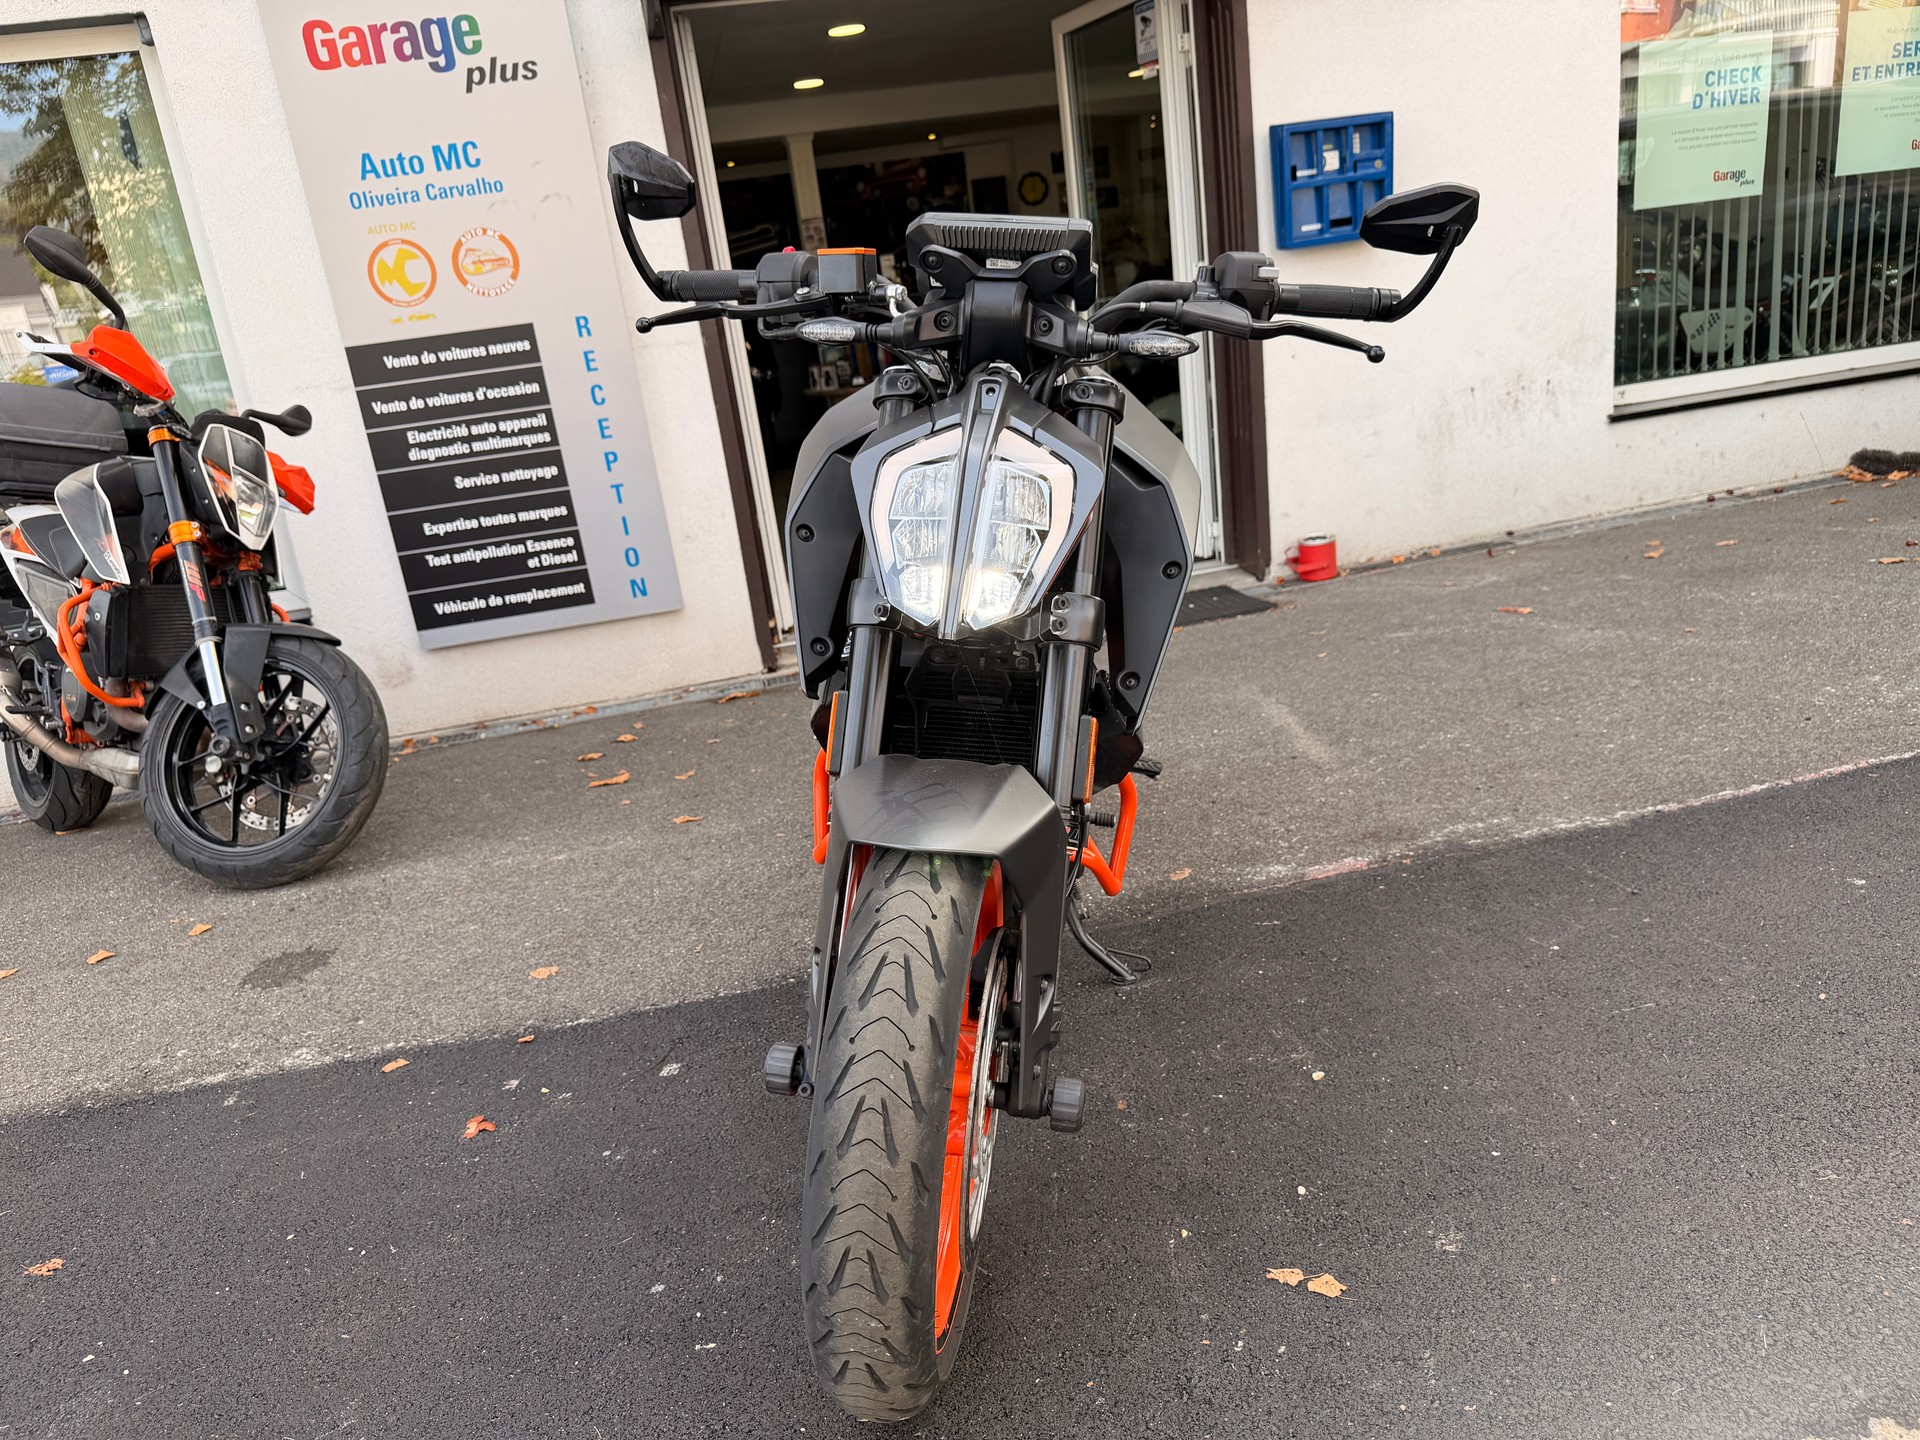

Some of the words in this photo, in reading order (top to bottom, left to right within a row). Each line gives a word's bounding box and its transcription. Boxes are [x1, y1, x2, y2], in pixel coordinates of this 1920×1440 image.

[302, 14, 482, 73] Garage
[466, 57, 538, 93] plus
[1705, 66, 1762, 87] CHECK
[1852, 66, 1871, 81] ET
[361, 152, 424, 181] Auto
[432, 141, 481, 172] MC
[1713, 169, 1746, 182] Garage
[350, 187, 420, 210] Oliveira
[425, 177, 504, 201] Carvalho
[368, 223, 397, 235] AUTO
[400, 221, 416, 232] MC
[460, 228, 483, 244] AUTO
[486, 228, 501, 240] MC
[383, 353, 419, 370] Vente
[421, 349, 437, 365] de
[438, 344, 487, 362] voitures
[488, 339, 531, 356] neuves
[371, 399, 407, 415] Vente
[409, 394, 425, 410] de
[426, 389, 475, 407] voitures
[476, 381, 540, 401] d'occasion
[406, 426, 468, 445] Electricité
[470, 421, 497, 435] auto
[498, 413, 547, 434] appareil
[408, 443, 470, 463] diagnostic
[472, 431, 552, 454] multimarques
[575, 315, 649, 599] RECEPTION
[454, 472, 500, 490] Service
[501, 465, 558, 484] nettoyage
[423, 518, 479, 537] Expertise
[480, 511, 517, 527] toutes
[518, 505, 568, 524] marques
[425, 552, 451, 568] Test
[453, 543, 525, 564] antipollution
[526, 535, 574, 552] Essence
[527, 557, 541, 569] et
[542, 550, 578, 567] Diesel
[434, 596, 486, 616] Véhicule
[488, 593, 503, 608] de
[504, 582, 586, 605] remplacement
